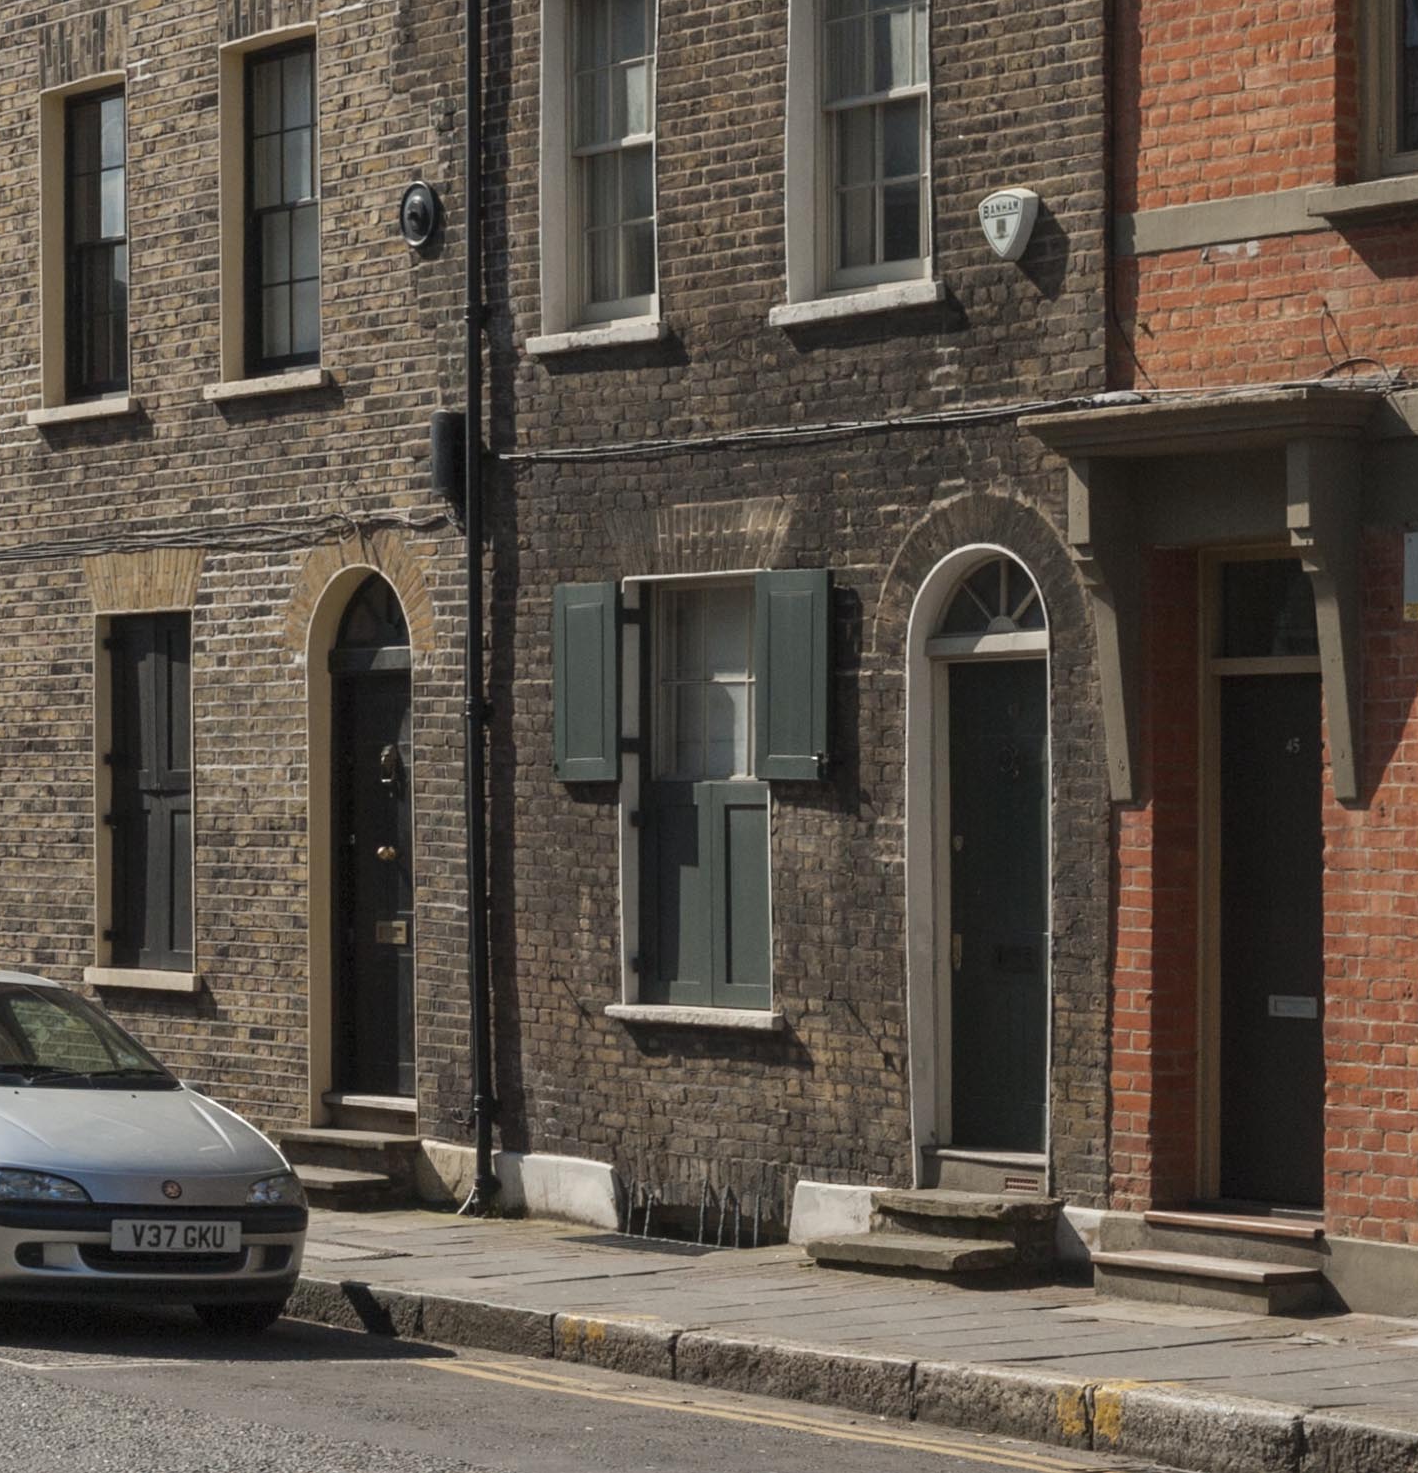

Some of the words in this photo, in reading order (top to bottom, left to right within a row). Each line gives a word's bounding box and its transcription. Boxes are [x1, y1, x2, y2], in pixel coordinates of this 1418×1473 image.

[983, 200, 1019, 219] BANHAM
[1285, 737, 1300, 754] 45
[132, 1224, 177, 1248] V37
[183, 1225, 225, 1249] GKU
